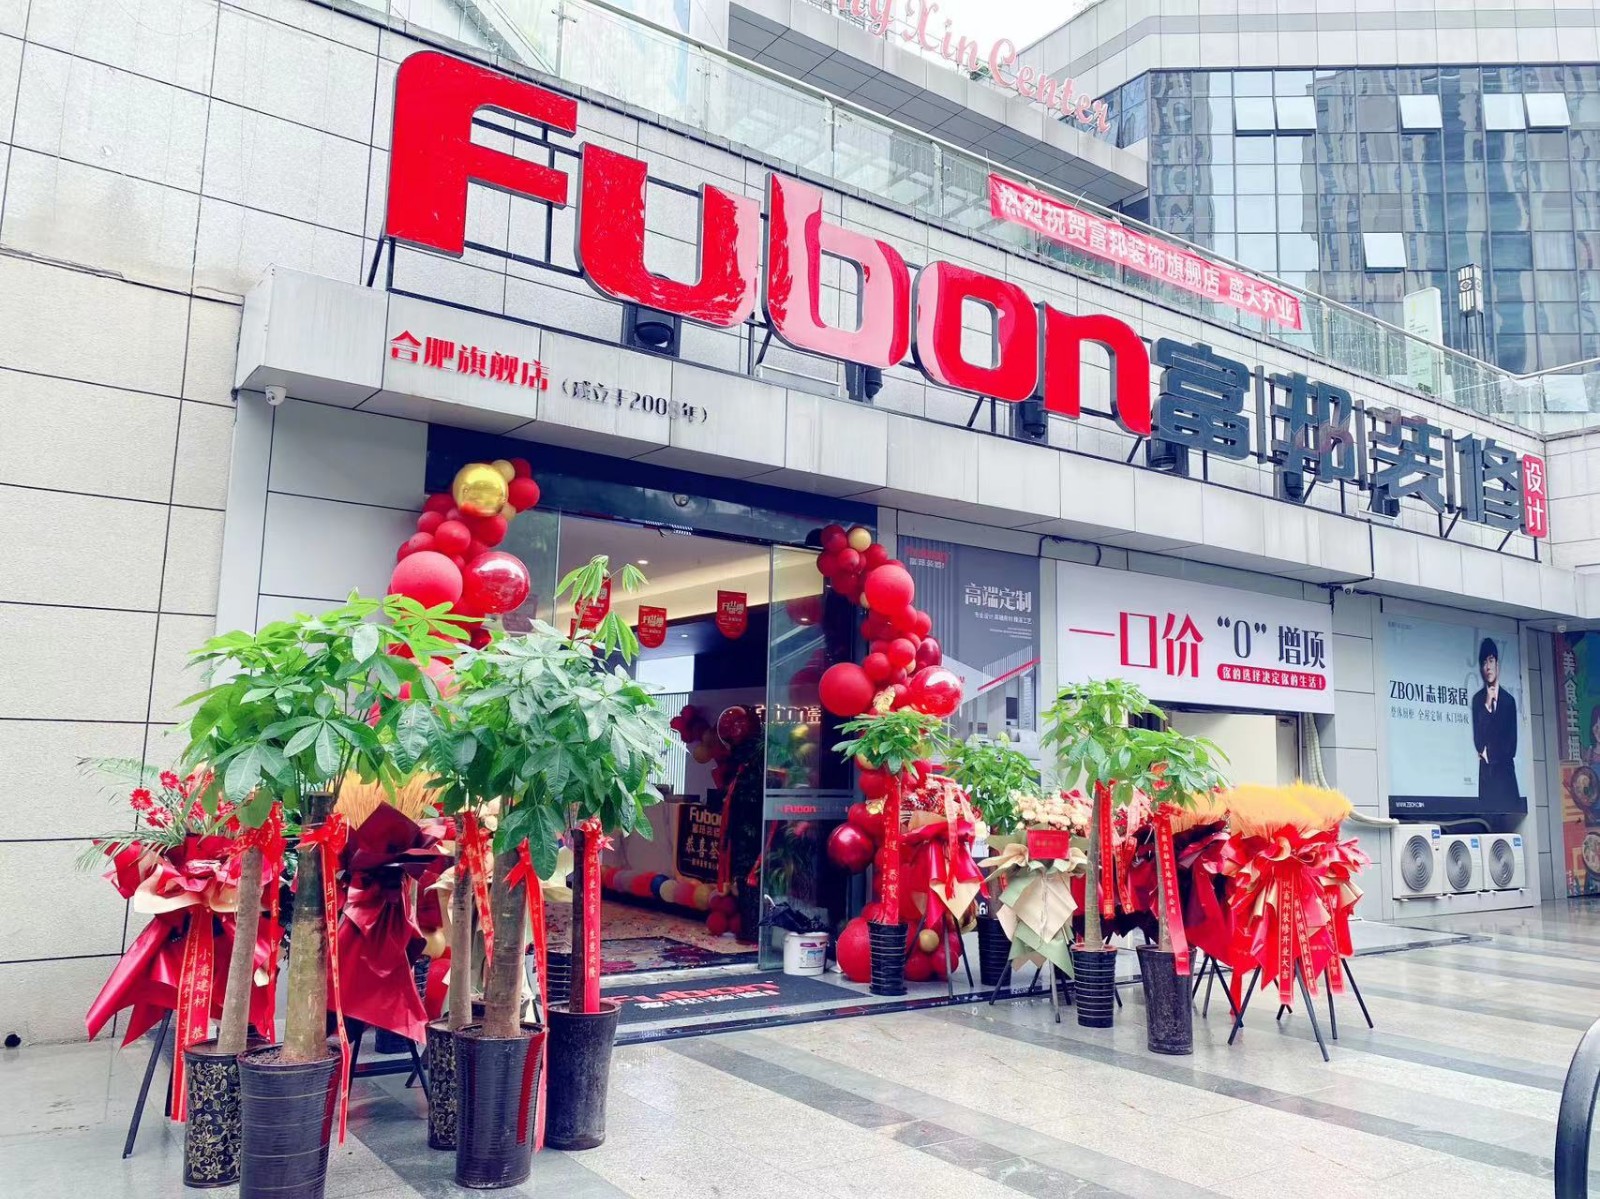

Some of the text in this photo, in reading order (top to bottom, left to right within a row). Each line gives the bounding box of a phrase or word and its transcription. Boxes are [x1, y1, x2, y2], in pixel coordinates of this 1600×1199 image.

[902, 0, 981, 72] Xin
[988, 37, 1111, 133] Center
[386, 50, 1152, 437] Fubon
[1000, 183, 1296, 322] 热烈祝贺富邦装饰旗舰店 盛大开业
[391, 329, 549, 391] 合肥旗舰店
[1525, 460, 1547, 532] 设计
[964, 582, 1032, 613] 高端定制
[1068, 611, 1203, 678] 一口价
[1390, 680, 1468, 706] ZBOM 志邦家居
[690, 806, 722, 826] Fubo
